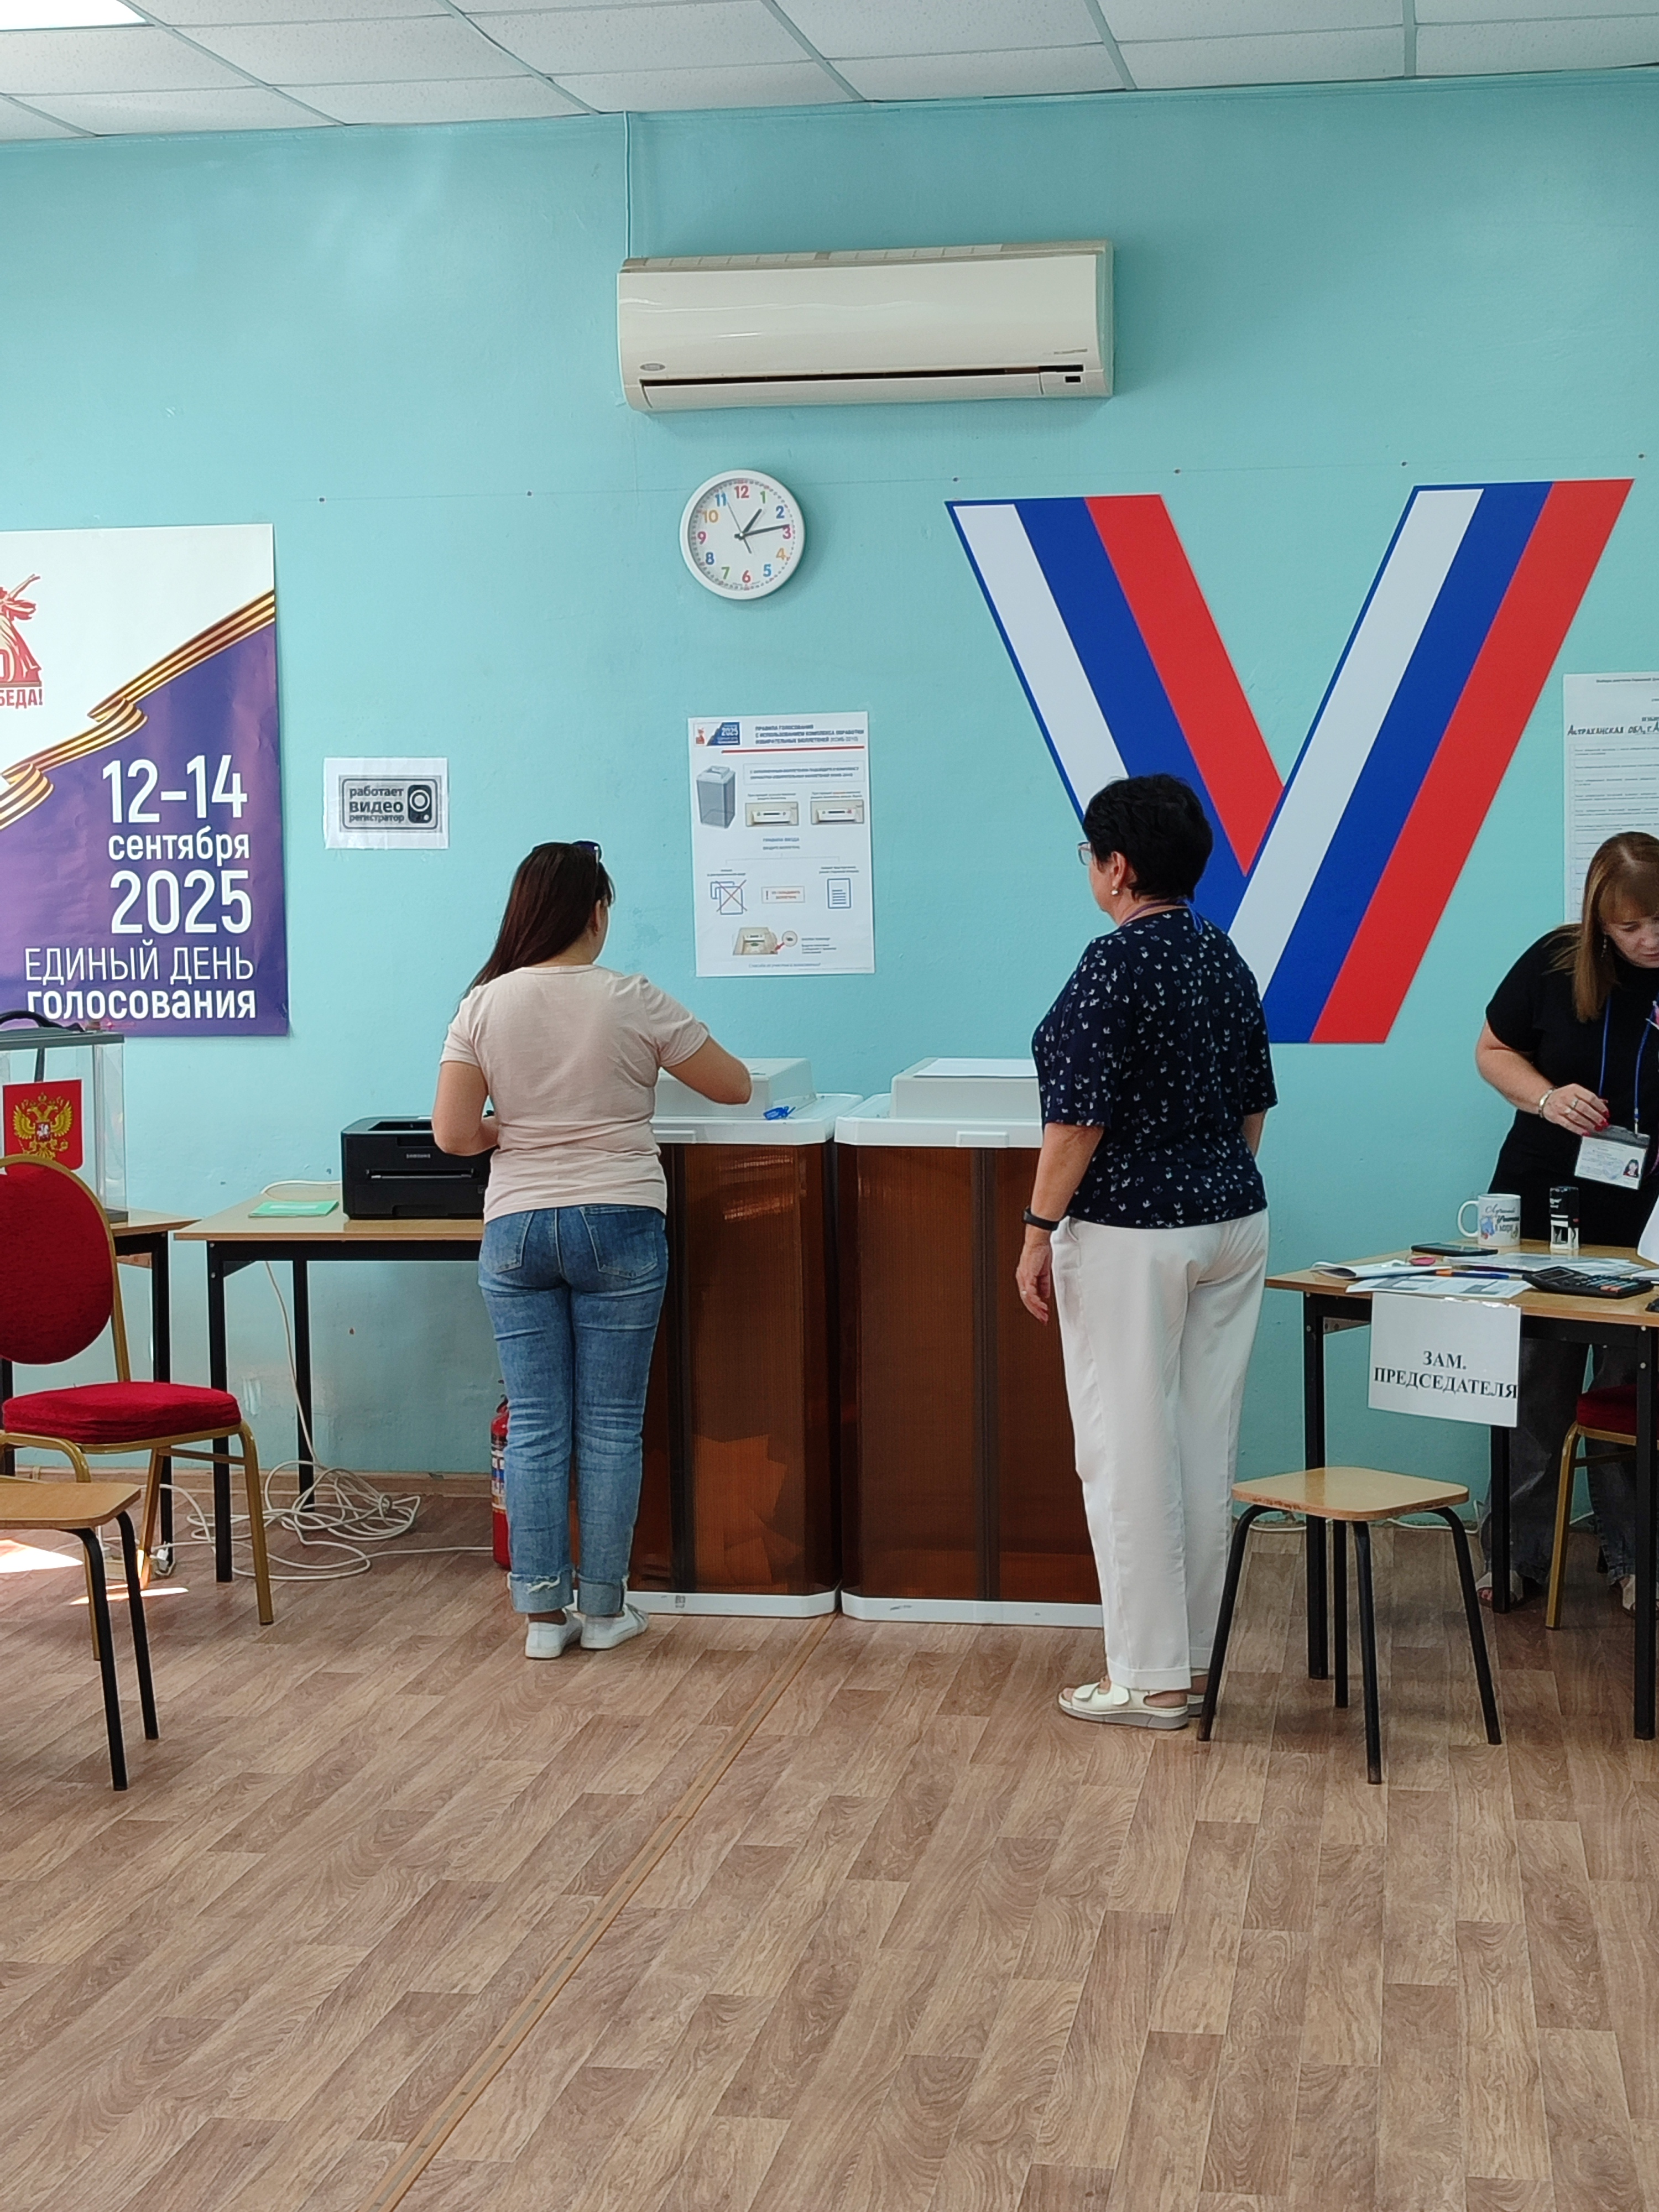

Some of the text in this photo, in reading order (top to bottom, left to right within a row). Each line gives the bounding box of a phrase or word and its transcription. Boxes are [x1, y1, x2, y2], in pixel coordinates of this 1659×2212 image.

[734, 486, 749, 499] 12
[760, 491, 765, 504] 1
[715, 493, 727, 507] 11
[702, 510, 718, 523] 10
[776, 505, 785, 519] 2
[697, 531, 706, 545] 9
[782, 525, 791, 539] 3
[705, 552, 714, 565] 8
[776, 548, 785, 560] 4
[722, 566, 730, 580] 7
[742, 570, 750, 583] 6
[763, 564, 771, 577] 5
[349, 785, 404, 799] работает
[349, 801, 404, 814] видео
[349, 815, 405, 823] регистратор
[108, 826, 250, 867] сентября
[110, 869, 252, 934] 2025
[24, 939, 254, 985] ЕДИНЫЙ ДЕНЬ
[27, 989, 256, 1019] голосования
[1422, 1350, 1467, 1370] ЗАМ.
[1374, 1367, 1518, 1399] ПРЕДСЕДАТЕЛЯ
